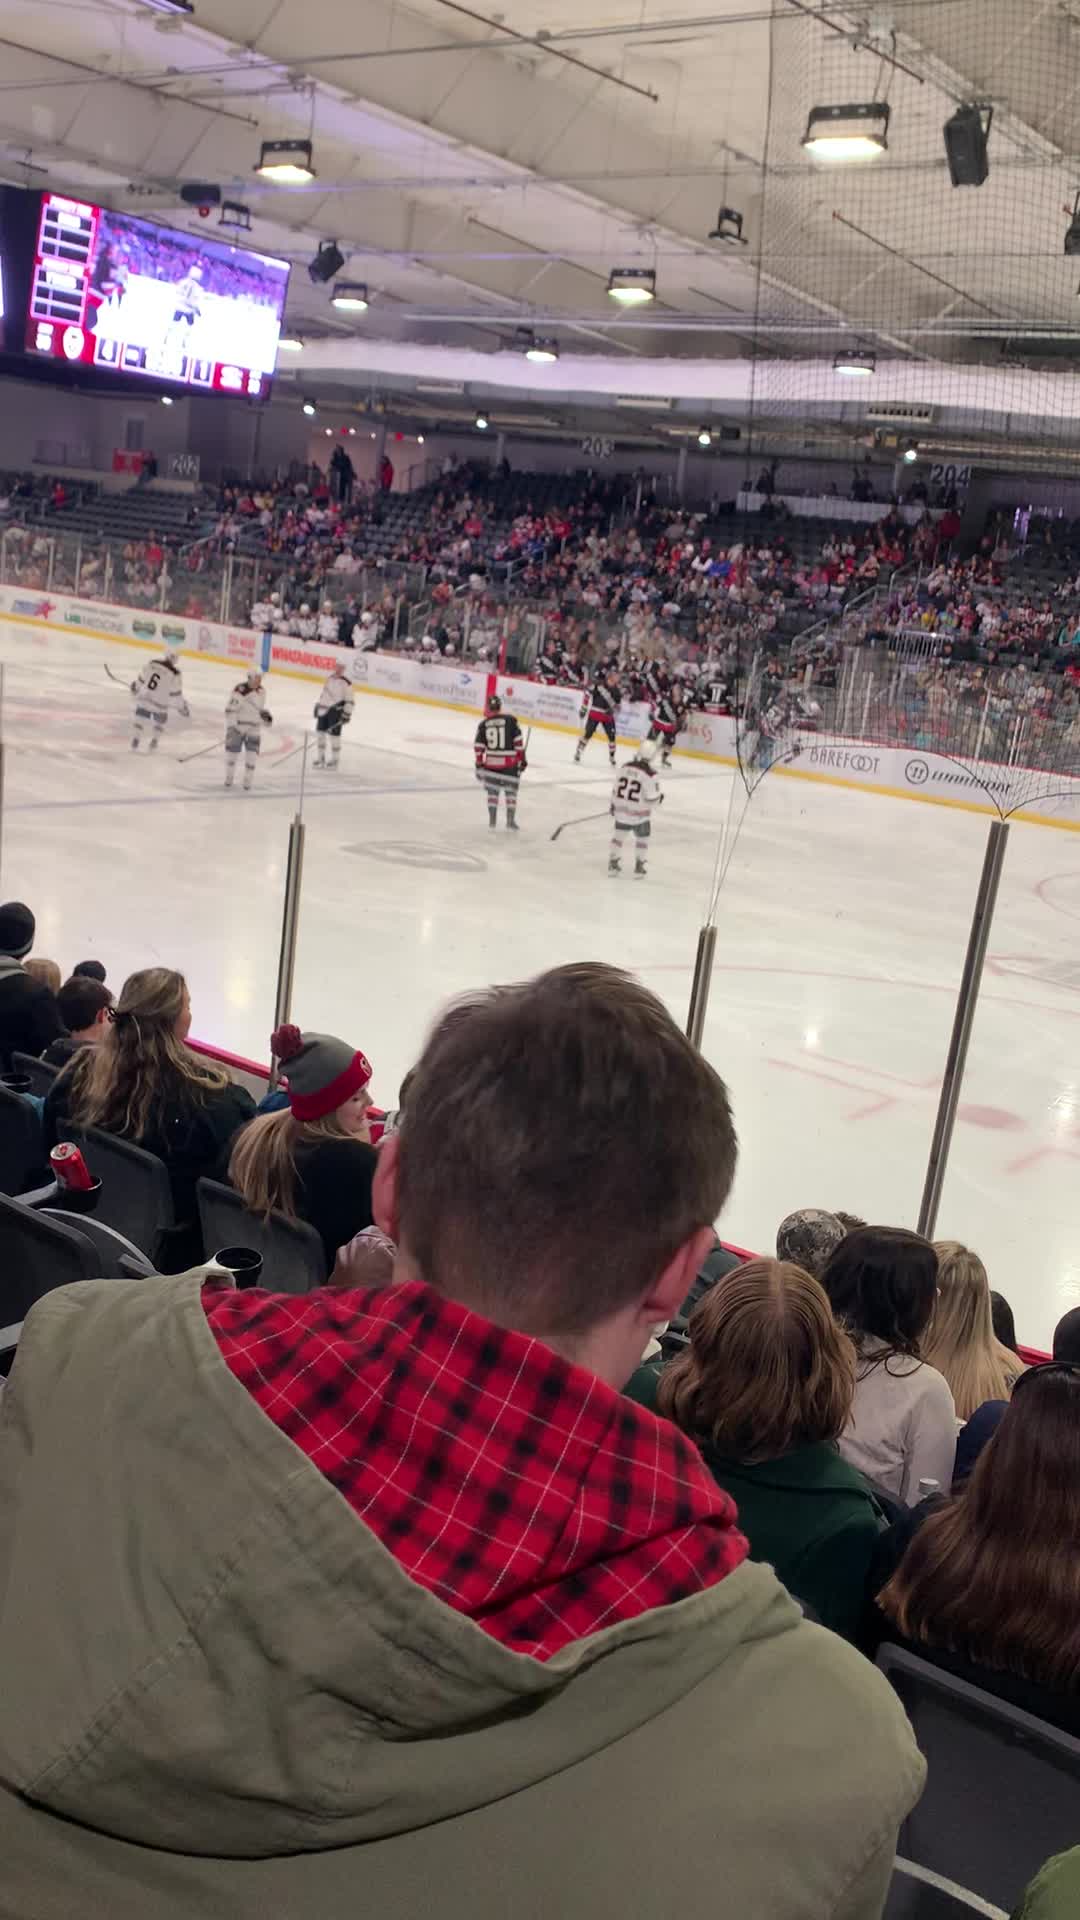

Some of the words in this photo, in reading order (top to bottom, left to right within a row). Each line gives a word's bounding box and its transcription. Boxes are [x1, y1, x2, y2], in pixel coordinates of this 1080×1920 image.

[933, 464, 970, 486] 204
[148, 673, 161, 691] 6
[485, 727, 505, 749] 91
[810, 747, 881, 774] BAREFOOT
[617, 777, 641, 802] 22
